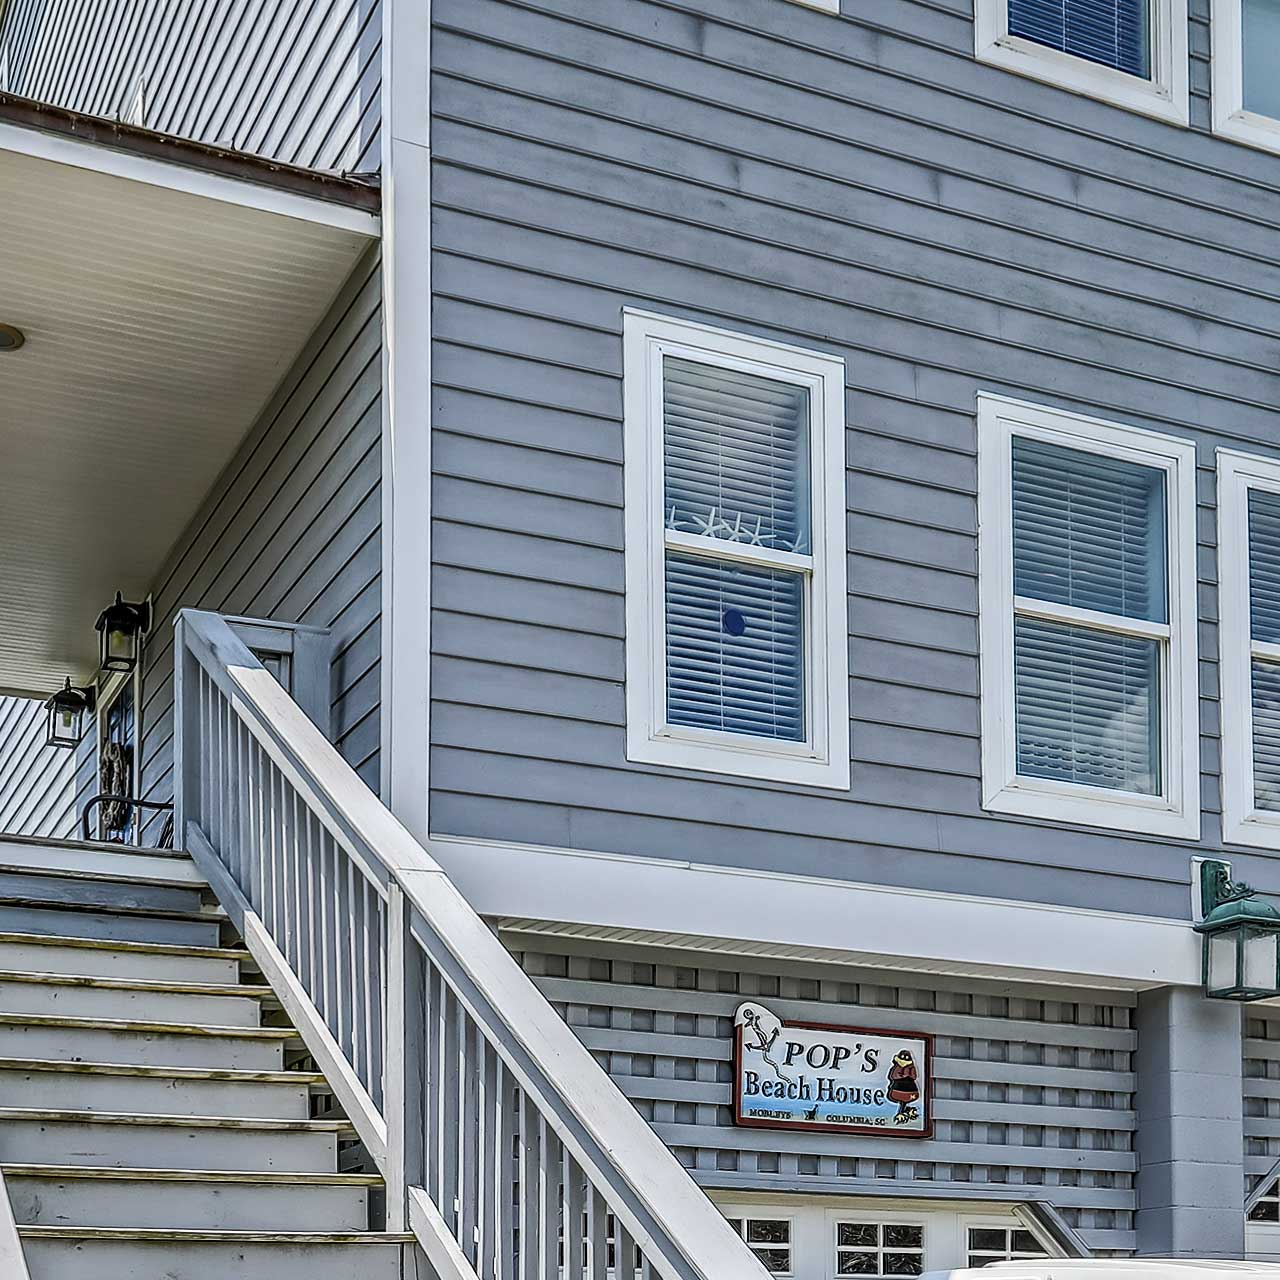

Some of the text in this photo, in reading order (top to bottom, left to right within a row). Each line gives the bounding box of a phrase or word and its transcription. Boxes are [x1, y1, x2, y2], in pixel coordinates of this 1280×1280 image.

[783, 1041, 880, 1073] POP'S
[744, 1070, 885, 1106] Beach House
[874, 1117, 886, 1126] SC
